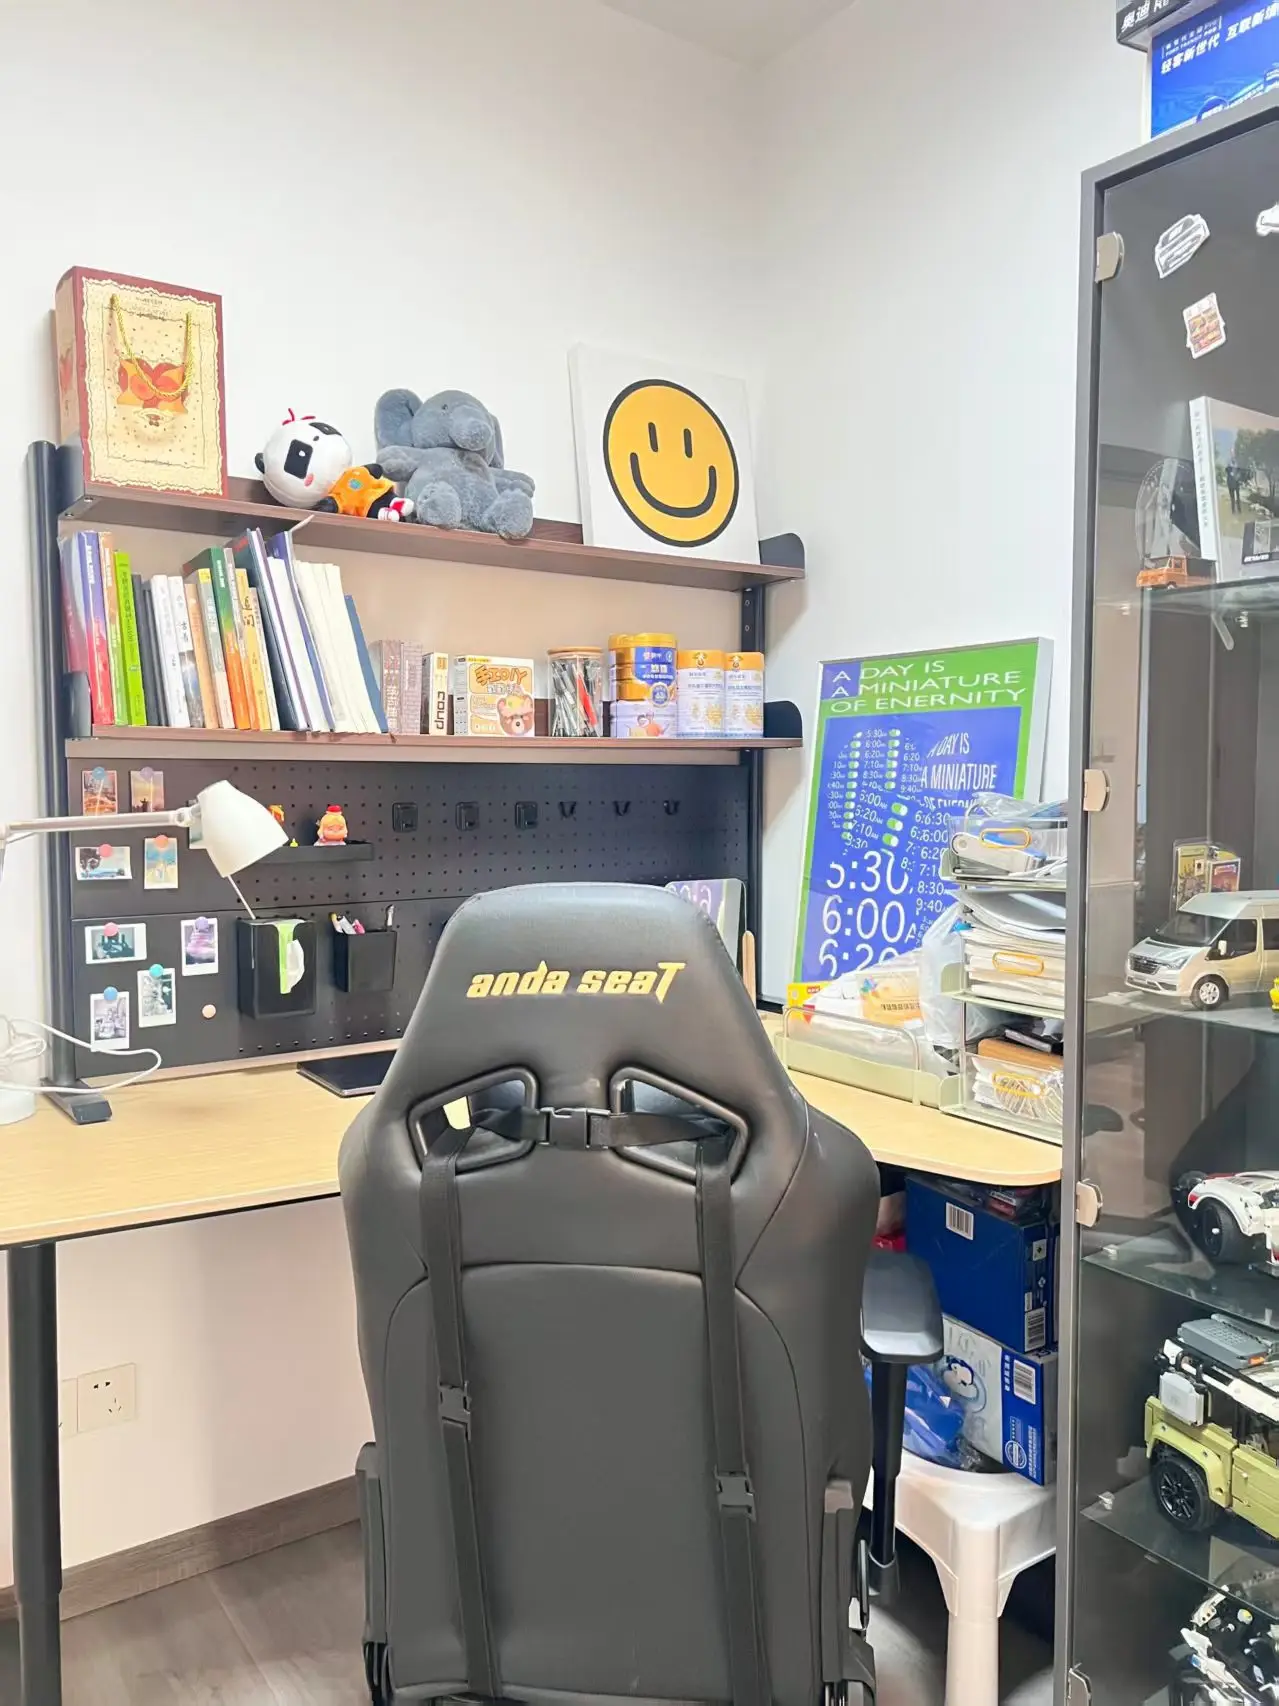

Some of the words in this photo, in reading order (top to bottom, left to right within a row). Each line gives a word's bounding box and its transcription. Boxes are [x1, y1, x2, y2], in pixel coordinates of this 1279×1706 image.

[831, 686, 849, 697] A
[857, 670, 1021, 696] MINIATURE
[832, 670, 851, 681] A
[860, 663, 914, 680] DAY
[924, 660, 945, 673] IS
[831, 700, 867, 713] OF
[875, 688, 1026, 710] ENERNITY
[960, 732, 970, 754] IS
[931, 763, 997, 791] MINIATURE
[466, 960, 571, 998] anda
